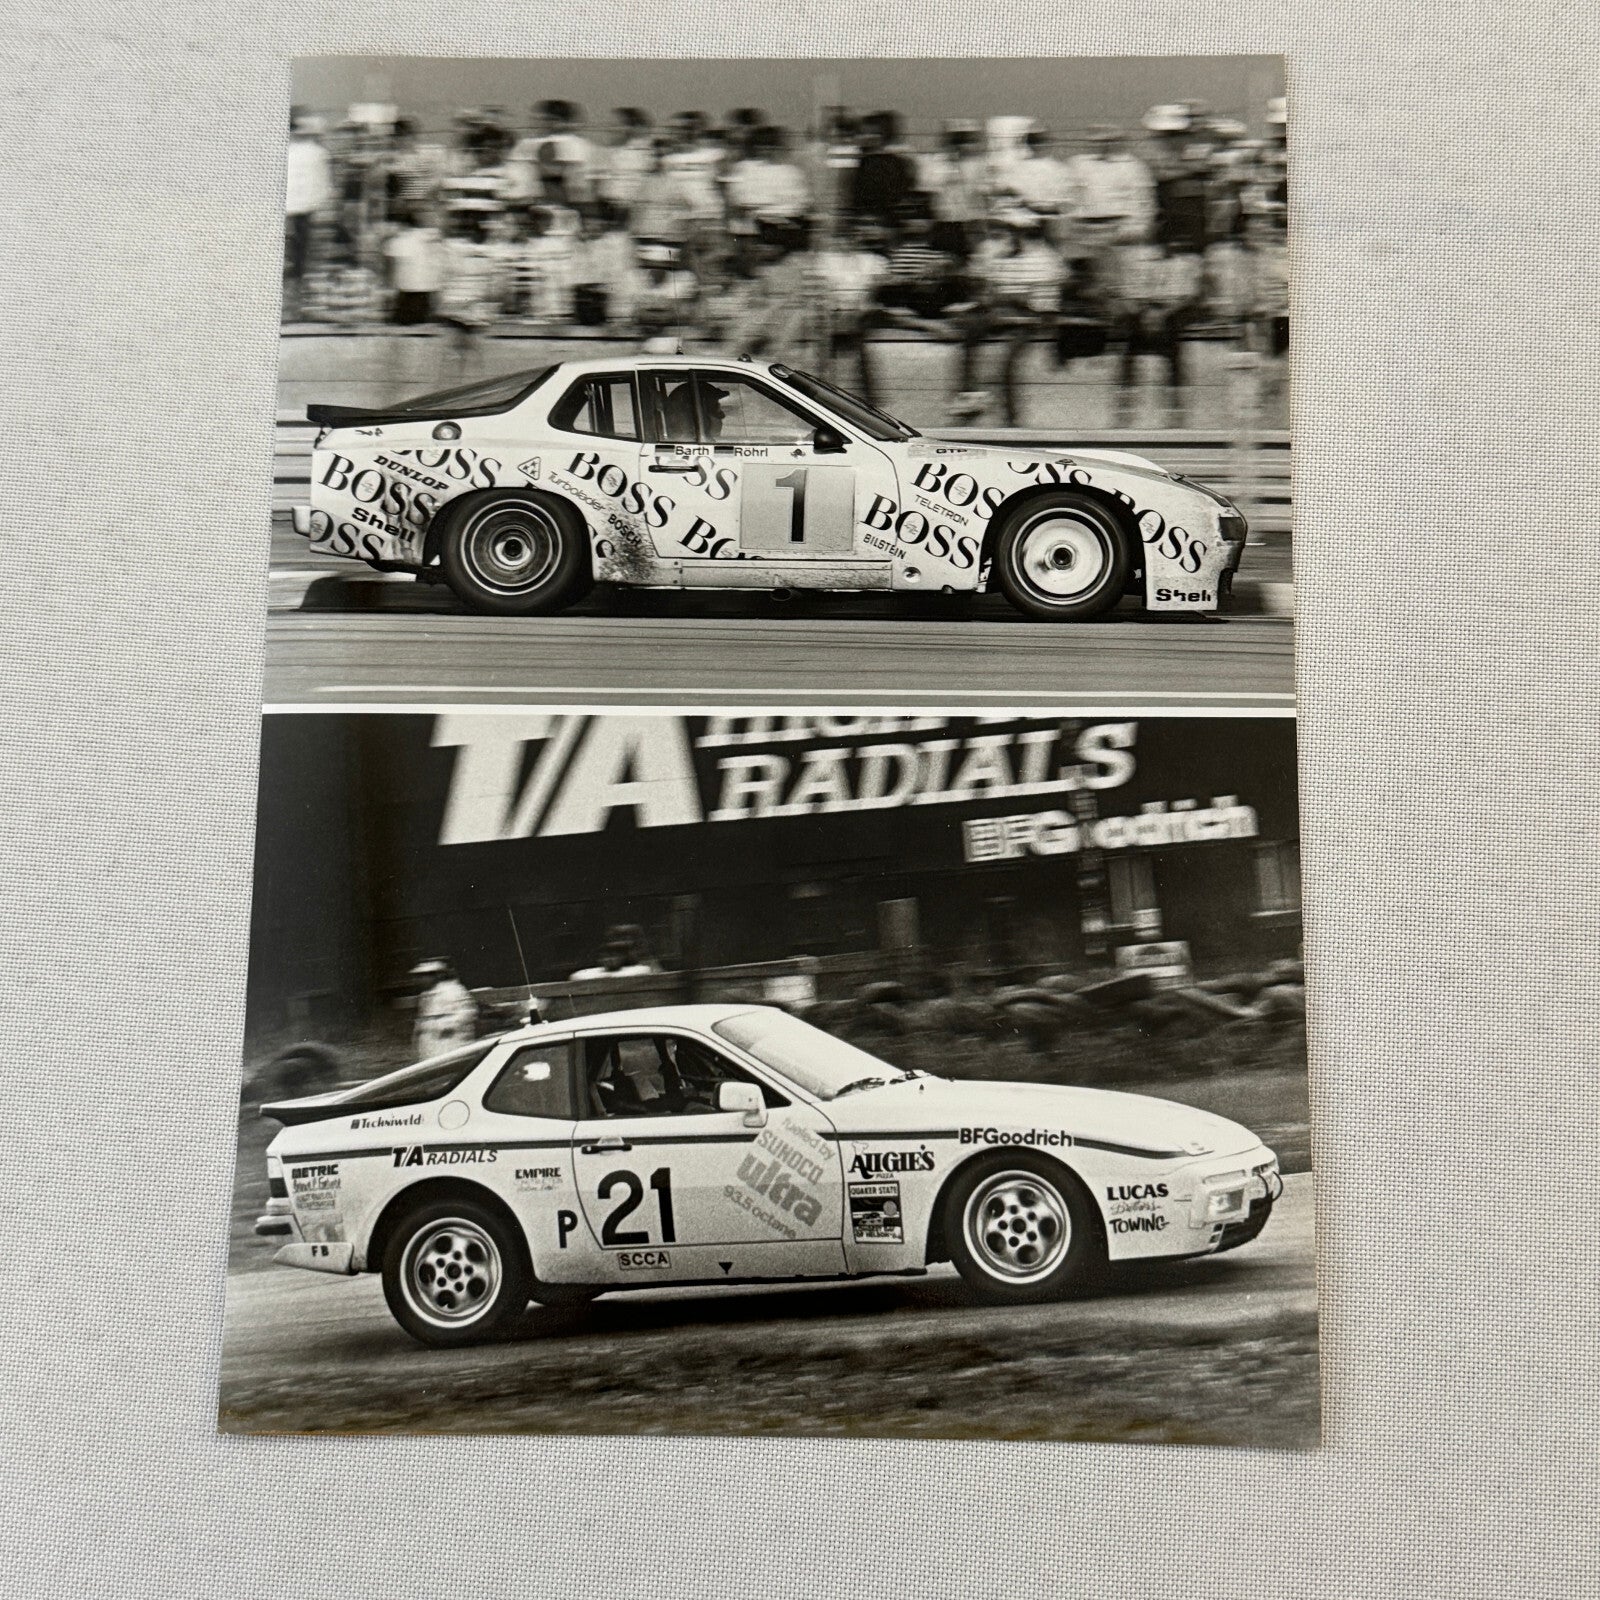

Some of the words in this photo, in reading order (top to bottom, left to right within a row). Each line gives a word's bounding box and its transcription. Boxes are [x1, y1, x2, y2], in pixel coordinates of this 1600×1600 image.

[390, 448, 502, 488] OSS
[675, 446, 709, 456] Barth
[734, 447, 768, 458] Röhrl
[318, 454, 437, 525] BOSS
[373, 455, 449, 490] DUNLOP
[548, 471, 606, 511] Turbolader
[564, 452, 676, 528] BOSS
[775, 467, 808, 543] 1
[915, 494, 969, 526] TELETRON
[351, 507, 416, 543] Shell
[608, 513, 643, 549] BOSCH
[860, 492, 980, 569] BOSS
[863, 533, 907, 560] BILSTEIN
[430, 714, 704, 845] T/A
[707, 722, 1138, 823] RADIALS
[962, 795, 1259, 862] BFGodrich
[393, 1145, 424, 1167] T/A
[426, 1149, 498, 1166] RADIALS
[960, 1127, 1073, 1147] BFGoodrich
[292, 1163, 339, 1180] METRIC
[515, 1167, 561, 1180] EMPIRE
[757, 1129, 824, 1186] SUNOCO
[848, 1144, 935, 1180] AUGIE'S
[597, 1167, 676, 1246] 21
[737, 1152, 823, 1227] ultra
[1106, 1183, 1169, 1201] LUCAS
[558, 1209, 579, 1249] P
[723, 1184, 753, 1211] 93.5
[751, 1205, 797, 1239] octane
[1108, 1213, 1171, 1234] TOWING
[620, 1252, 669, 1267] SCCA
